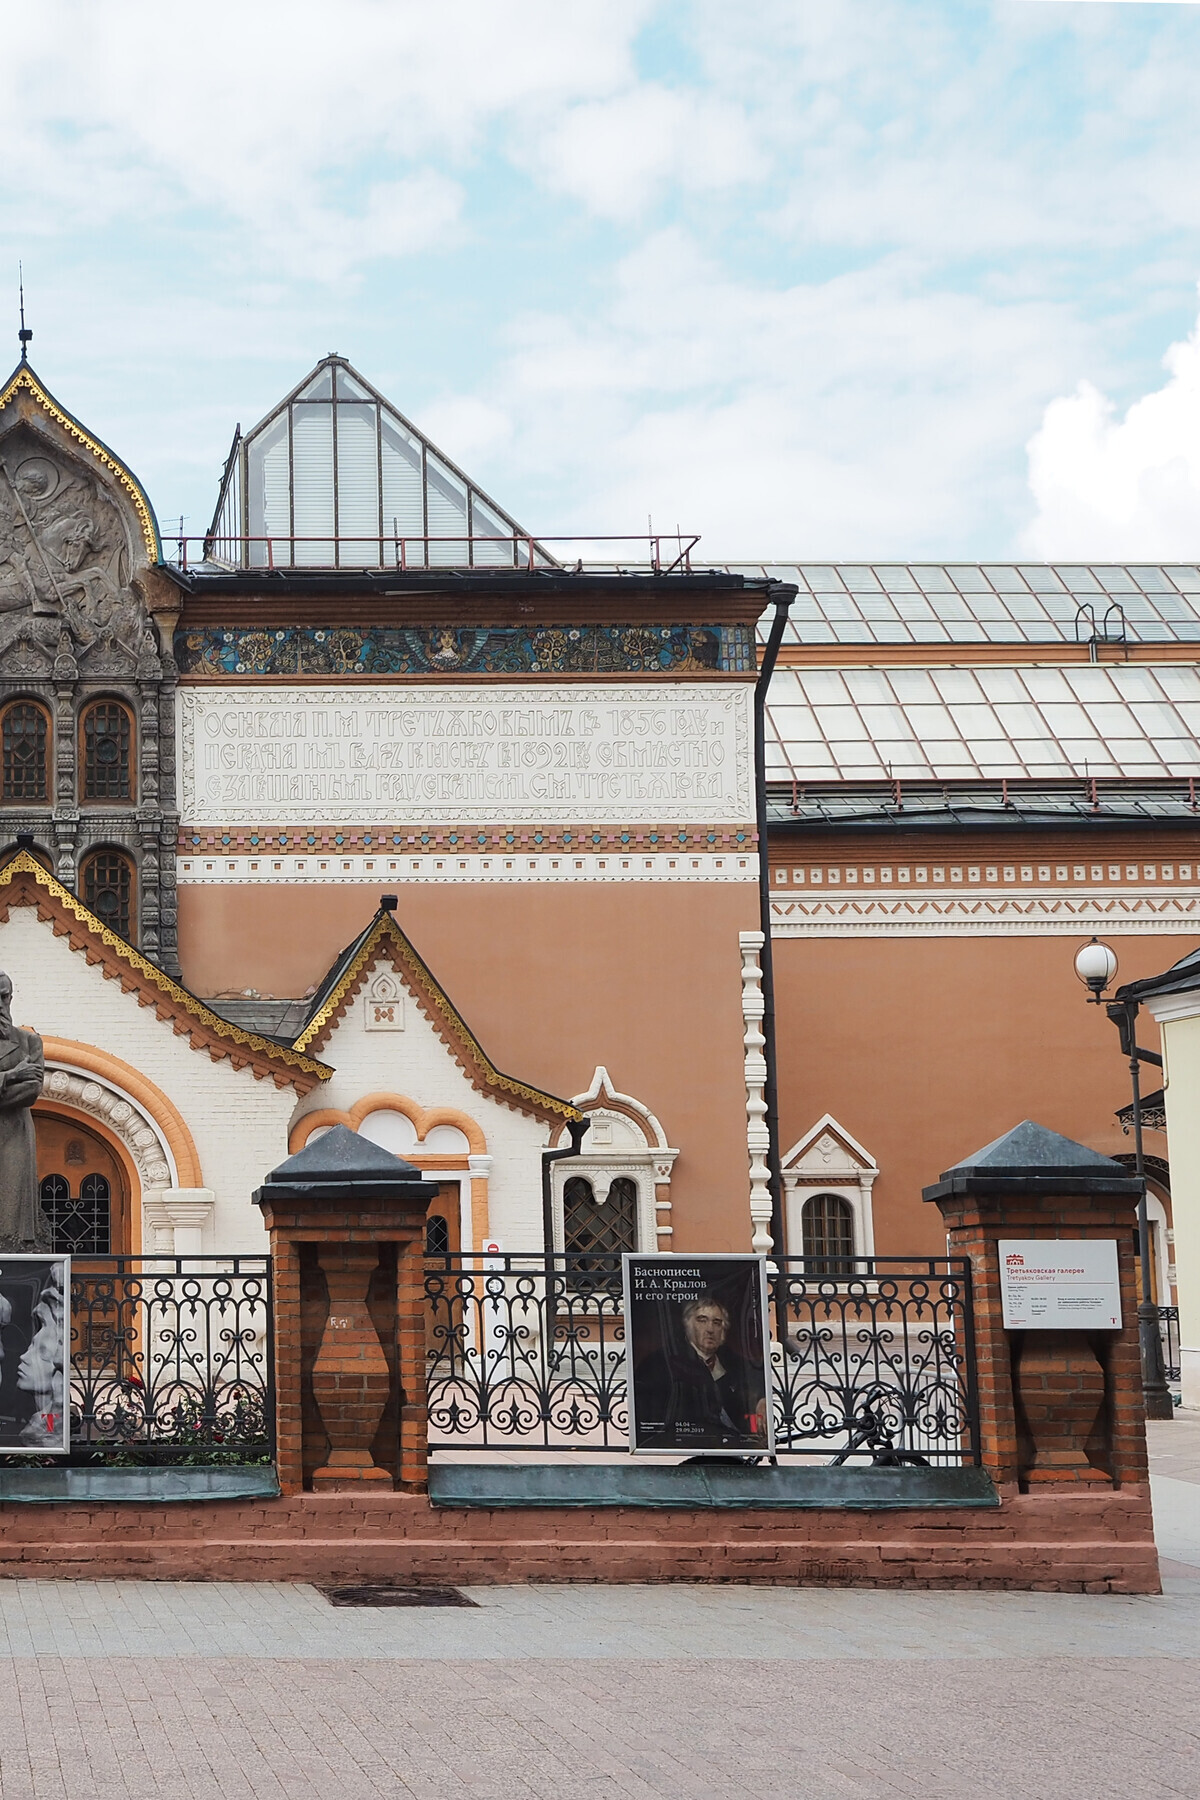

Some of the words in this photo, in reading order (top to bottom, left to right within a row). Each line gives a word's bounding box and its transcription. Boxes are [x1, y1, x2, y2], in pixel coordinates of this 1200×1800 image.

[606, 709, 667, 736] 1856
[634, 1266, 701, 1278] Баснописец
[1057, 1267, 1085, 1275] галерея
[1035, 1274, 1056, 1282] Gallery
[663, 1279, 707, 1291] Крылов
[645, 1292, 664, 1301] его
[666, 1292, 700, 1303] герои
